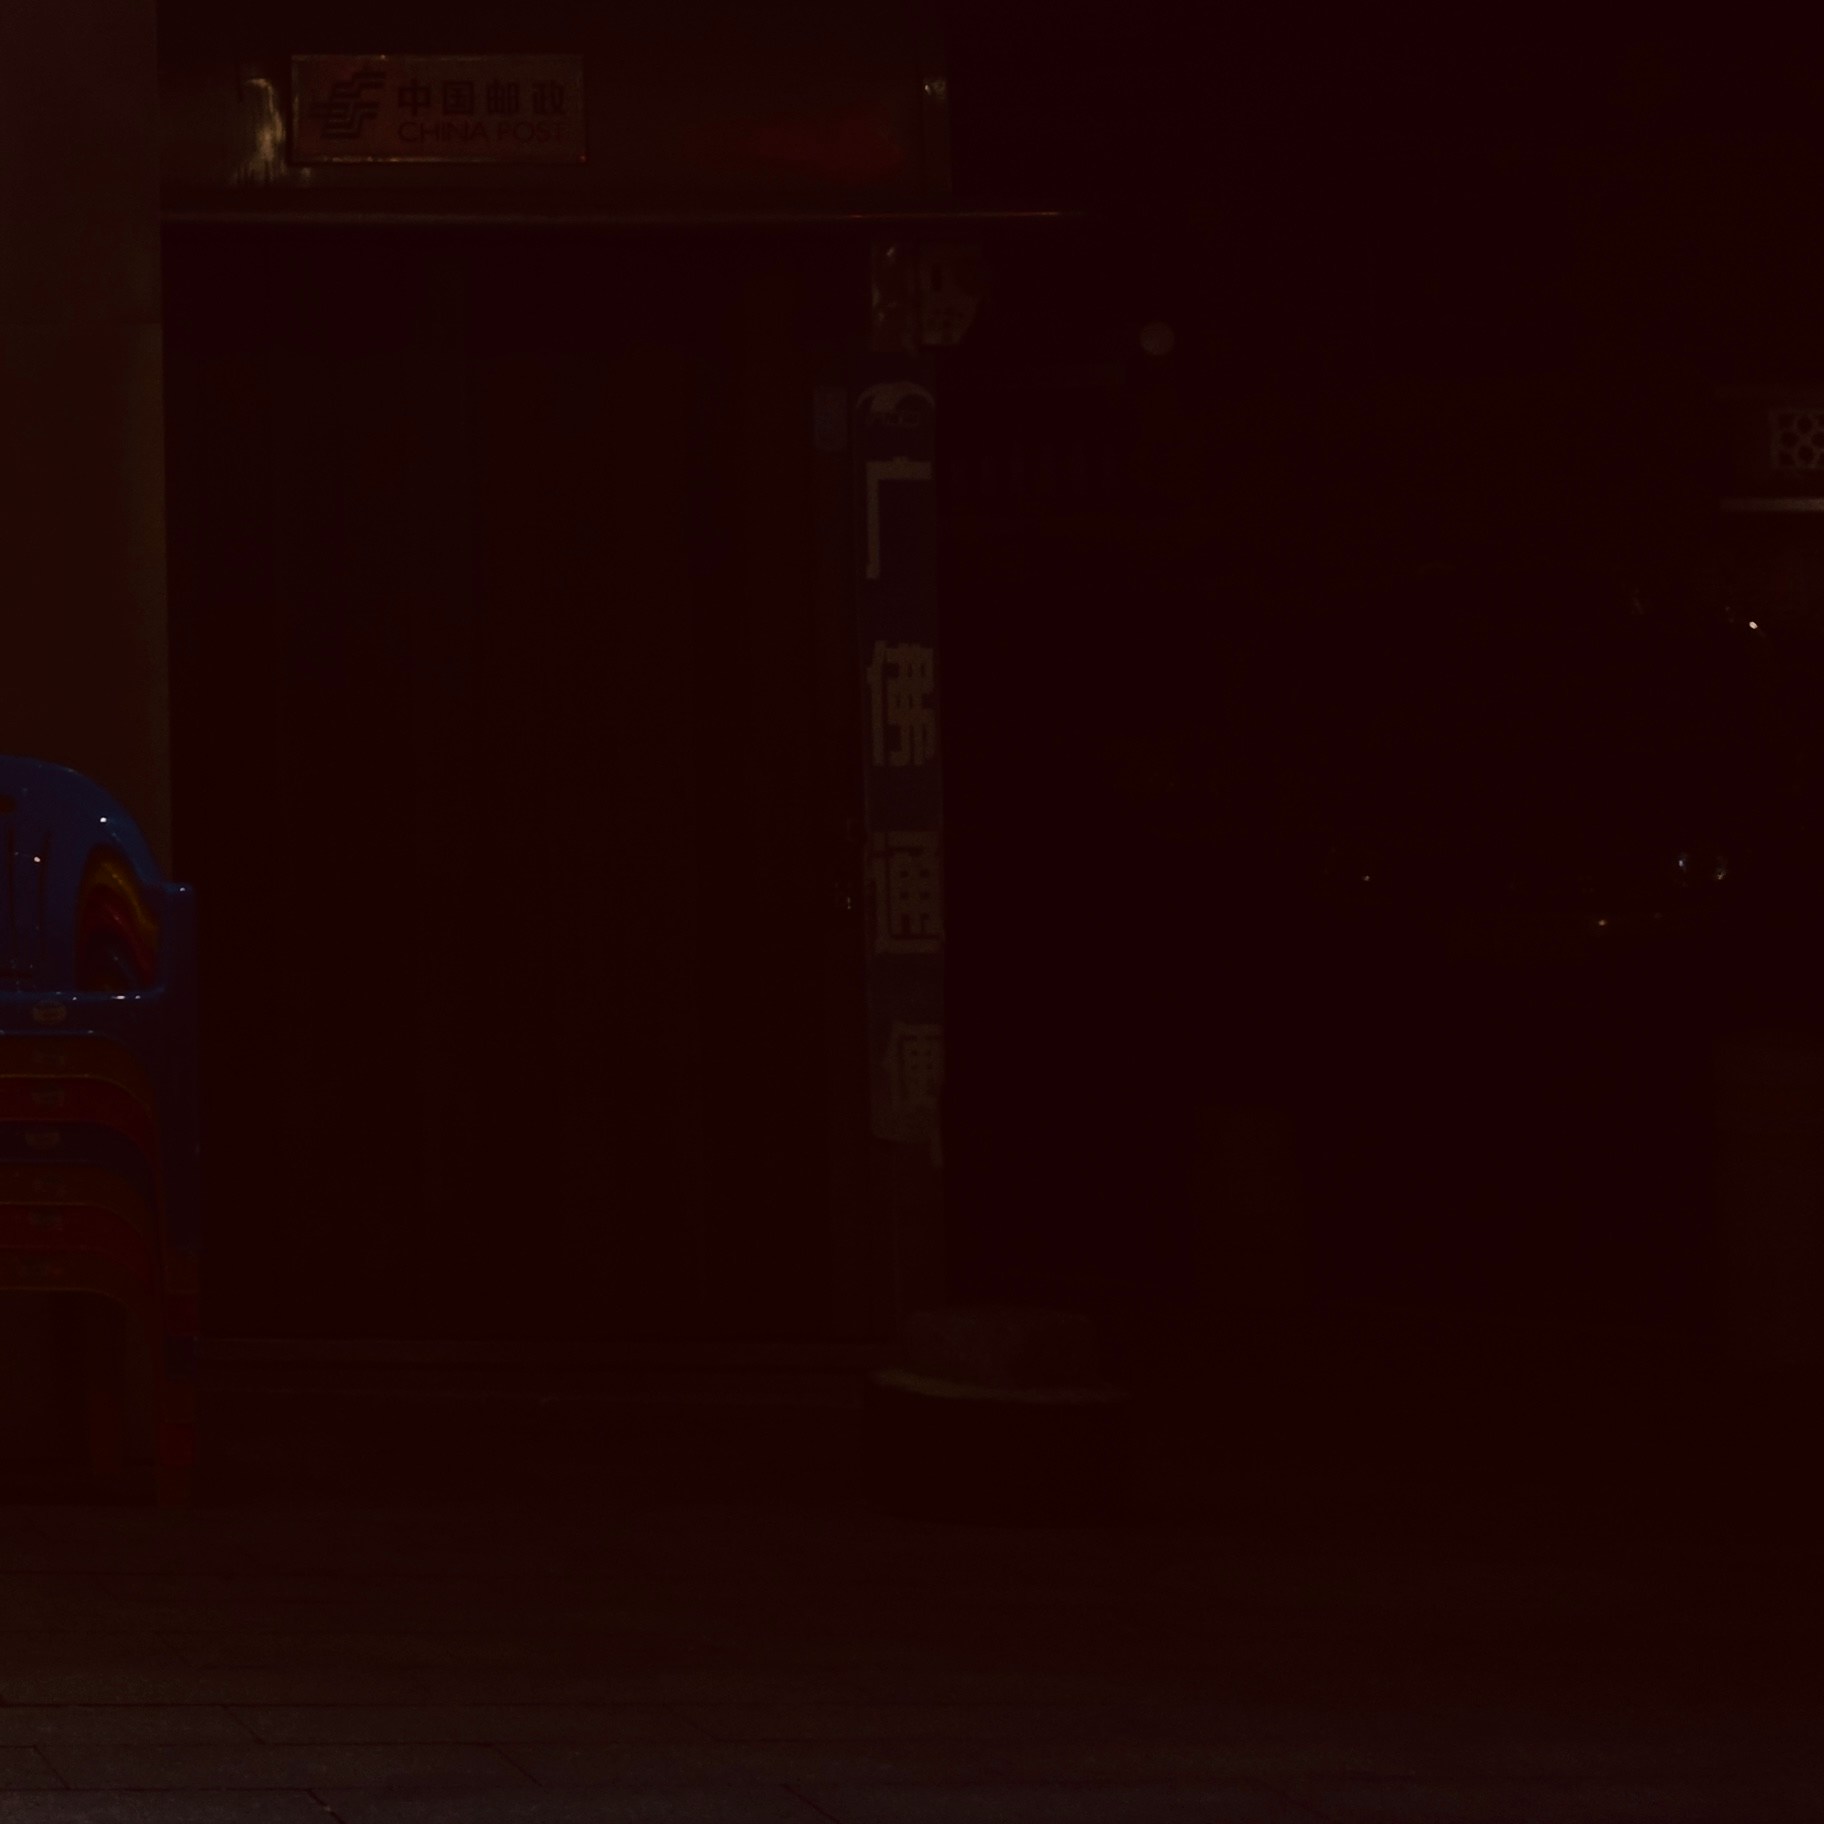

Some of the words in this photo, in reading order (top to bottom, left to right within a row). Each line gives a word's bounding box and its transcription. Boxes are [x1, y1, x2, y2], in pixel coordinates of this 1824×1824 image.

[398, 78, 566, 117] 中国邮政
[398, 121, 489, 143] CHINA
[497, 121, 565, 143] POST
